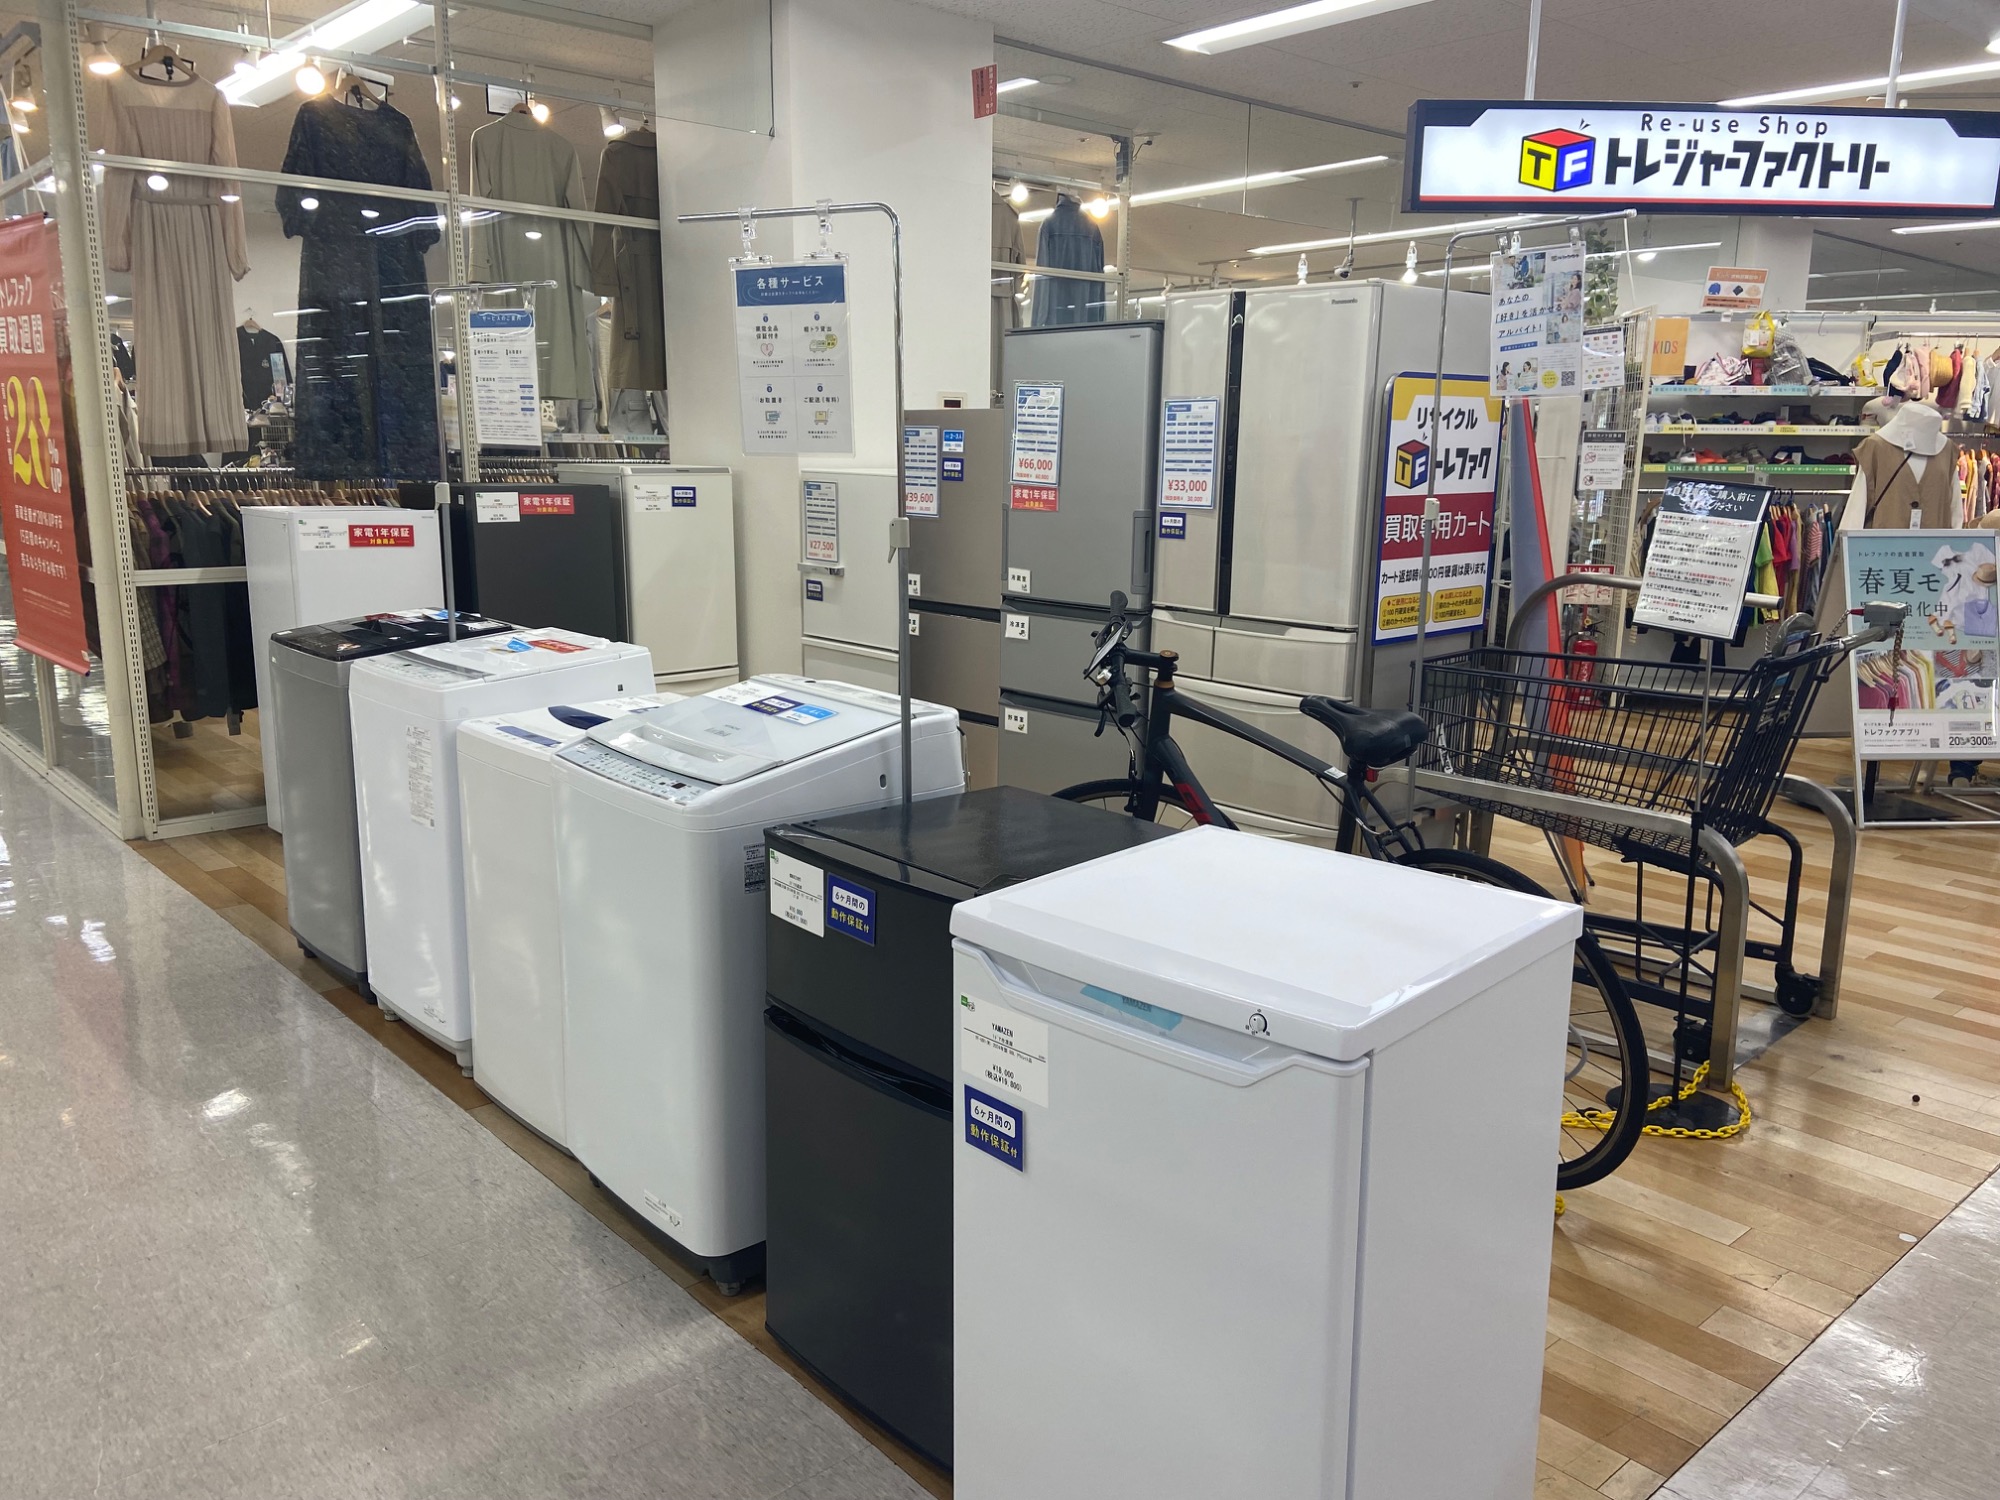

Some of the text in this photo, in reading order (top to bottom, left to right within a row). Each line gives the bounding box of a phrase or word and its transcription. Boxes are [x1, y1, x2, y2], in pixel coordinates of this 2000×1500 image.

[1641, 113, 1829, 138] Re-use Shop
[1527, 137, 1891, 190] TF トレジャーファクトリー
[757, 275, 824, 290] 各種サービス
[1499, 293, 1529, 306] あなたの
[1653, 340, 1679, 355] KIDS
[1018, 457, 1053, 471] ¥66,000
[1398, 455, 1427, 481] TF
[1168, 479, 1208, 493] ¥33,000
[523, 497, 571, 506] 家電1年保証
[1014, 488, 1056, 500] 家電1年保証
[353, 528, 410, 537] 家電1年保証
[810, 540, 834, 551] ¥27,500
[1381, 562, 1486, 584] カート返却時00円硬貨は戻ります。
[1858, 567, 1962, 594] 春夏モノ
[1391, 597, 1420, 606] ご使用になると
[1861, 601, 1947, 617] 強化中
[1864, 728, 1920, 736] トレファクアプリ
[834, 891, 865, 911] 6ヶ月間の
[831, 907, 870, 933] 動作保証付
[992, 1023, 1014, 1038] YAMAZEN
[992, 1064, 1015, 1080] ¥18,000
[974, 1105, 1012, 1131] 6ヶ月間の
[970, 1123, 1018, 1159] 動作保証付
